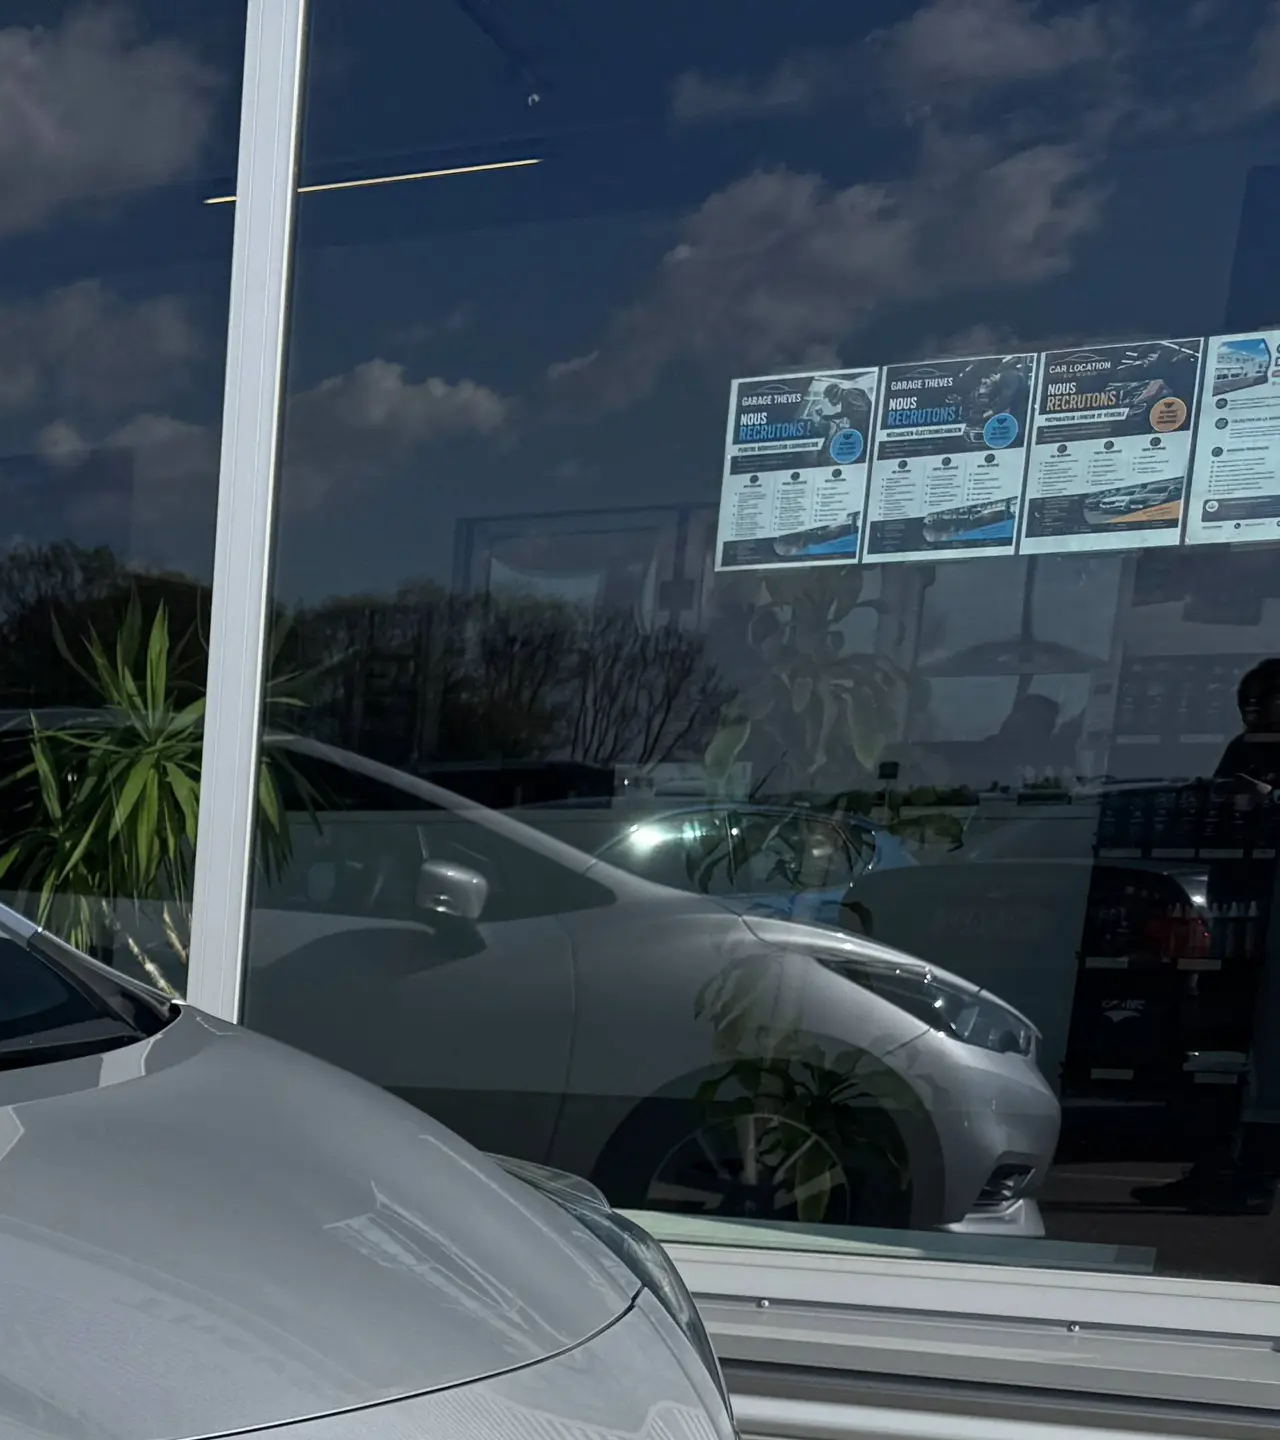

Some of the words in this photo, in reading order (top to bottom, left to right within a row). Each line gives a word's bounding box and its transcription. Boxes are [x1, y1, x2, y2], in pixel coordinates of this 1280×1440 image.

[1049, 365, 1067, 374] CAR
[1069, 361, 1111, 373] LOCATION
[891, 380, 922, 391] GARAGE
[925, 377, 953, 388] THEVES
[1048, 382, 1076, 396] NOUS
[742, 395, 772, 406] GARAGE
[774, 393, 802, 403] THEVES
[889, 396, 917, 411] NOUS
[1046, 391, 1117, 411] RECRUTONS
[740, 412, 768, 426] NOUS
[888, 406, 956, 426] RECRUTONS
[739, 422, 805, 440] RECRUTONS
